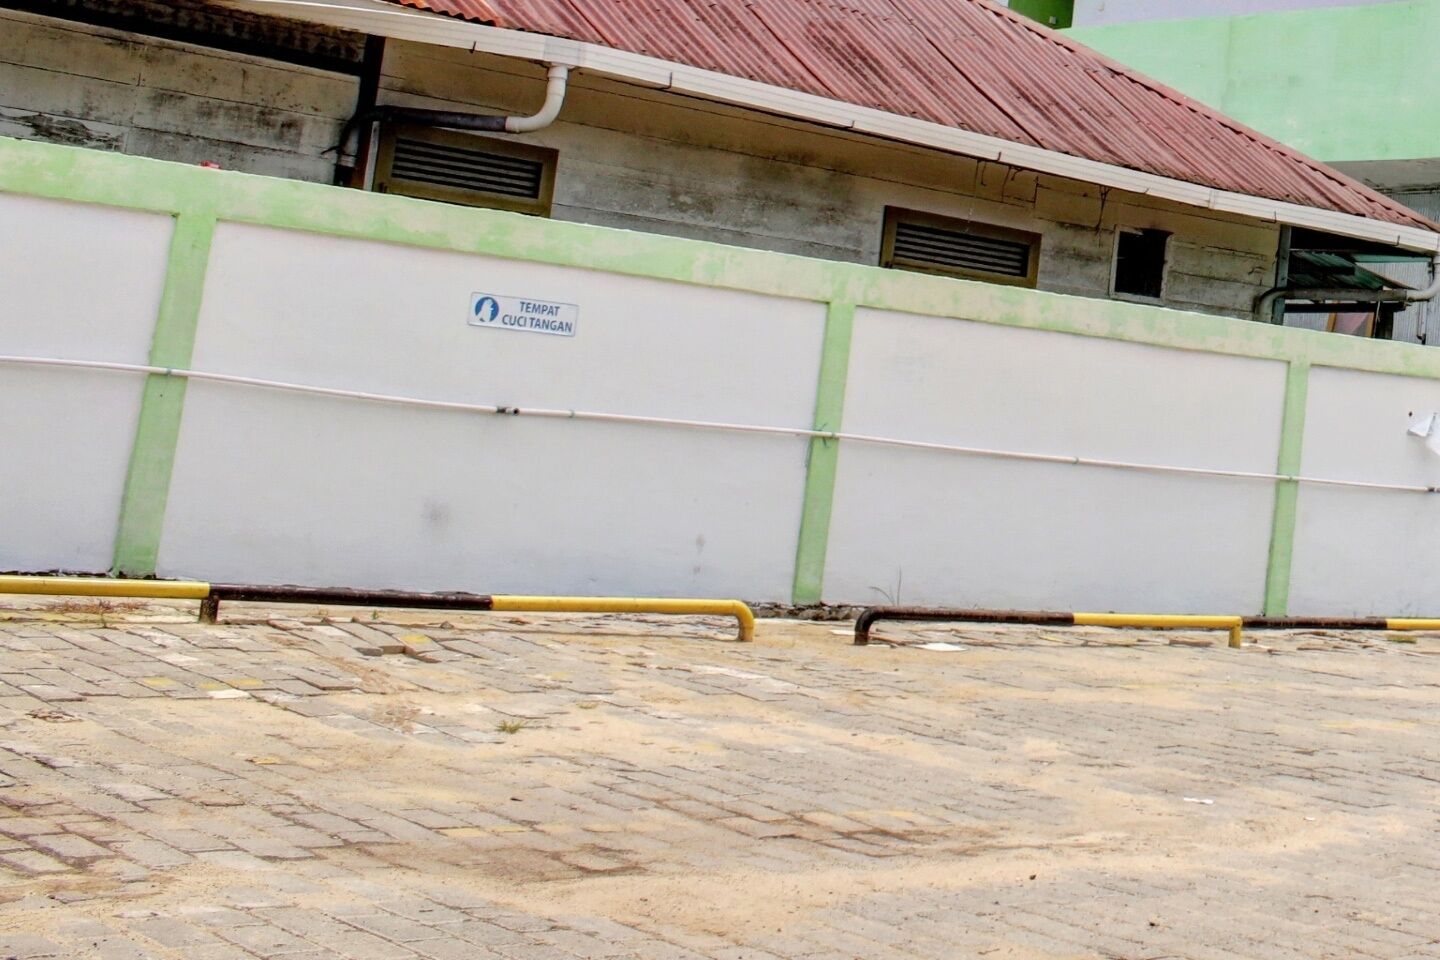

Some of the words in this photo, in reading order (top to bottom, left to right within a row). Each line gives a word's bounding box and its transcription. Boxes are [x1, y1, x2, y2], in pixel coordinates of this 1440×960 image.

[519, 301, 561, 317] TEMPAT
[502, 314, 527, 328] CUCI
[530, 317, 573, 333] TANGAN
